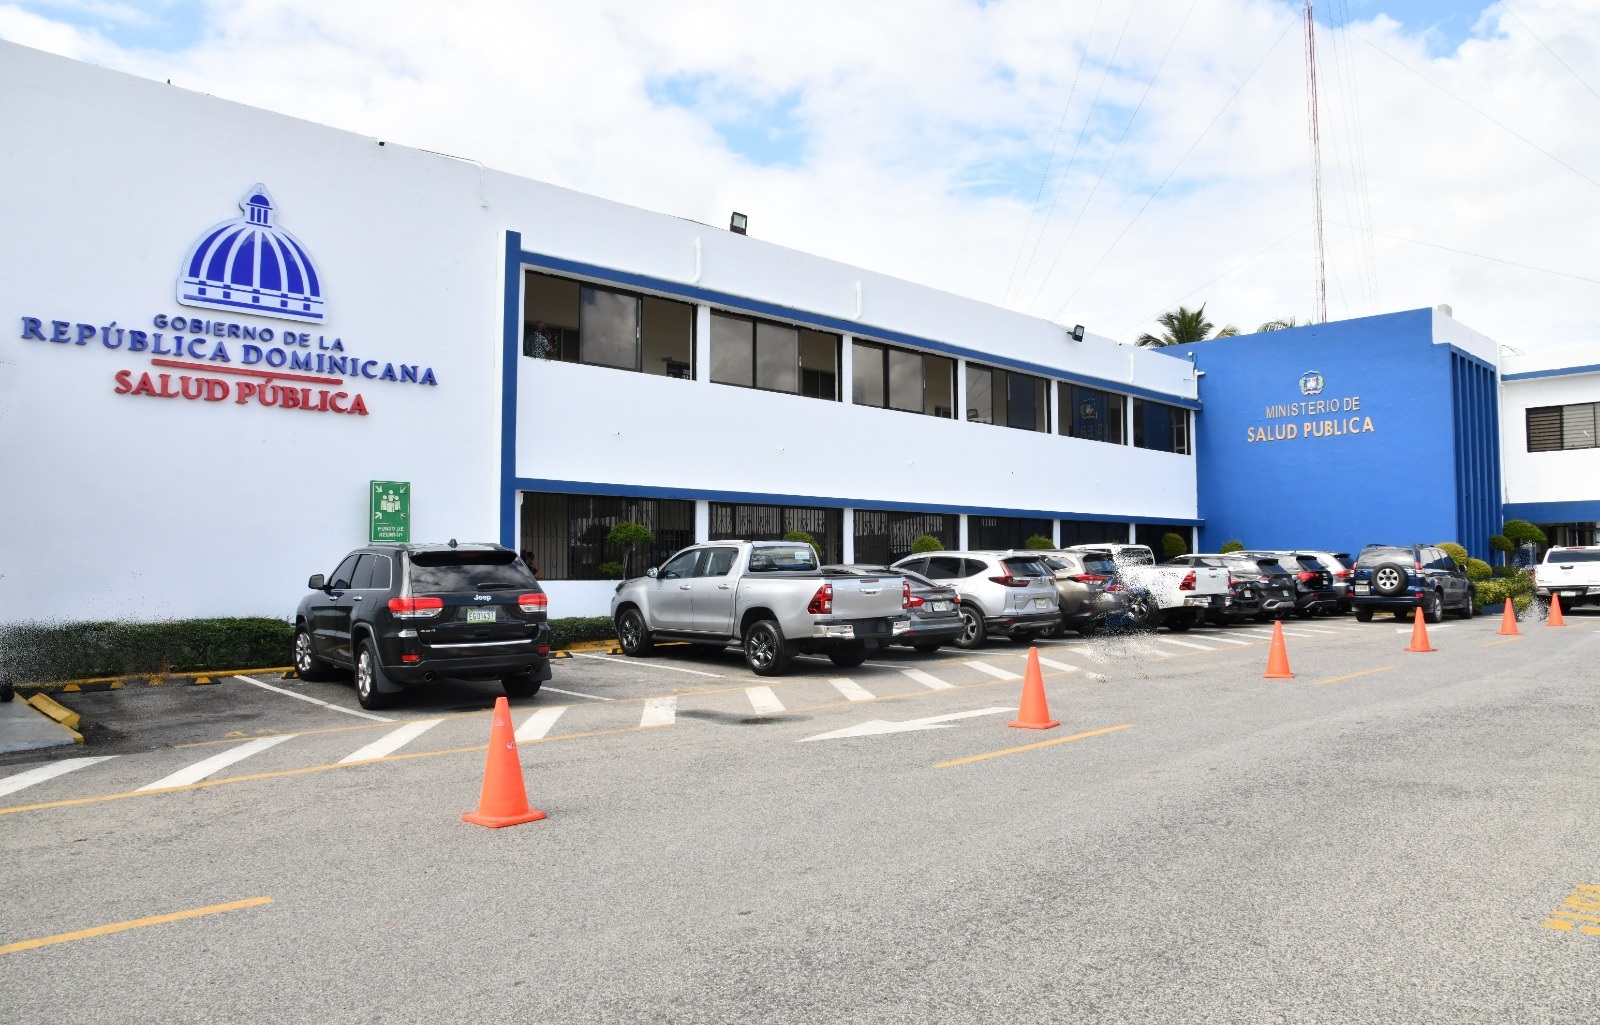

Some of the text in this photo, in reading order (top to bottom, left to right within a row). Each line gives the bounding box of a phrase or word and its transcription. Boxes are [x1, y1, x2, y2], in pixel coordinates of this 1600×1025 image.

[153, 314, 345, 352] GOBIERNO DE LA
[21, 316, 438, 386] REPÚBLICA DOMINICANA
[114, 369, 369, 415] SALUD PÚBLICA
[1266, 396, 1361, 419] MINISTERIO DE
[1247, 416, 1375, 443] SALUD PUBLICA
[473, 594, 492, 602] Jeep
